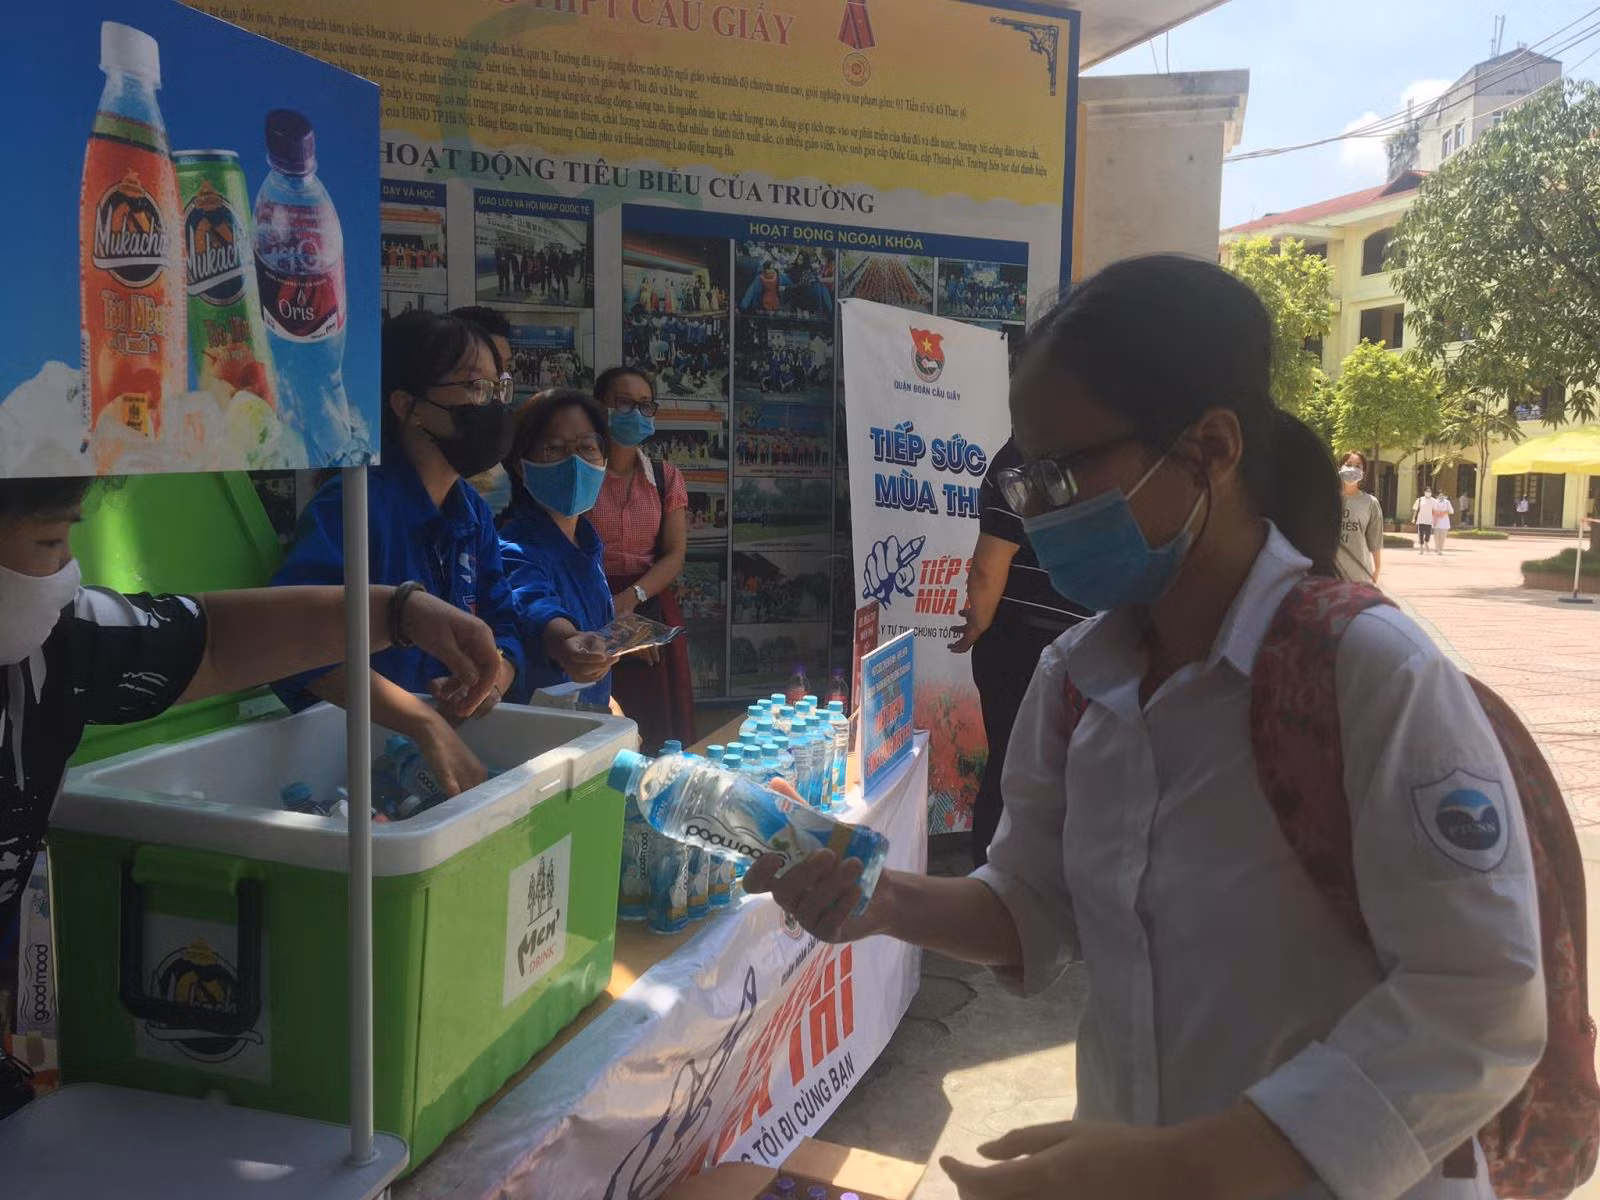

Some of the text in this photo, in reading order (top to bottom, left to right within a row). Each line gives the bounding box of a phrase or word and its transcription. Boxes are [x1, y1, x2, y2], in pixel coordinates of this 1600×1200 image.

[379, 141, 875, 213] HOẠT ĐỘNG TIÊU BIỂU CỦA TRƯỜNG
[750, 223, 923, 250] HOẠT ĐỘNG NGOẠI KHÓA
[278, 299, 315, 321] Oris
[870, 420, 986, 476] TIẾP SỨC
[874, 468, 938, 515] MÙA
[920, 556, 963, 585] TIẾP
[915, 584, 958, 615] MÙA
[913, 625, 937, 637] CHÚNG
[528, 943, 555, 974] DRINK
[34, 944, 49, 1021] goodmood
[751, 1051, 855, 1164] TÔI ĐI CÙNG BẠN
